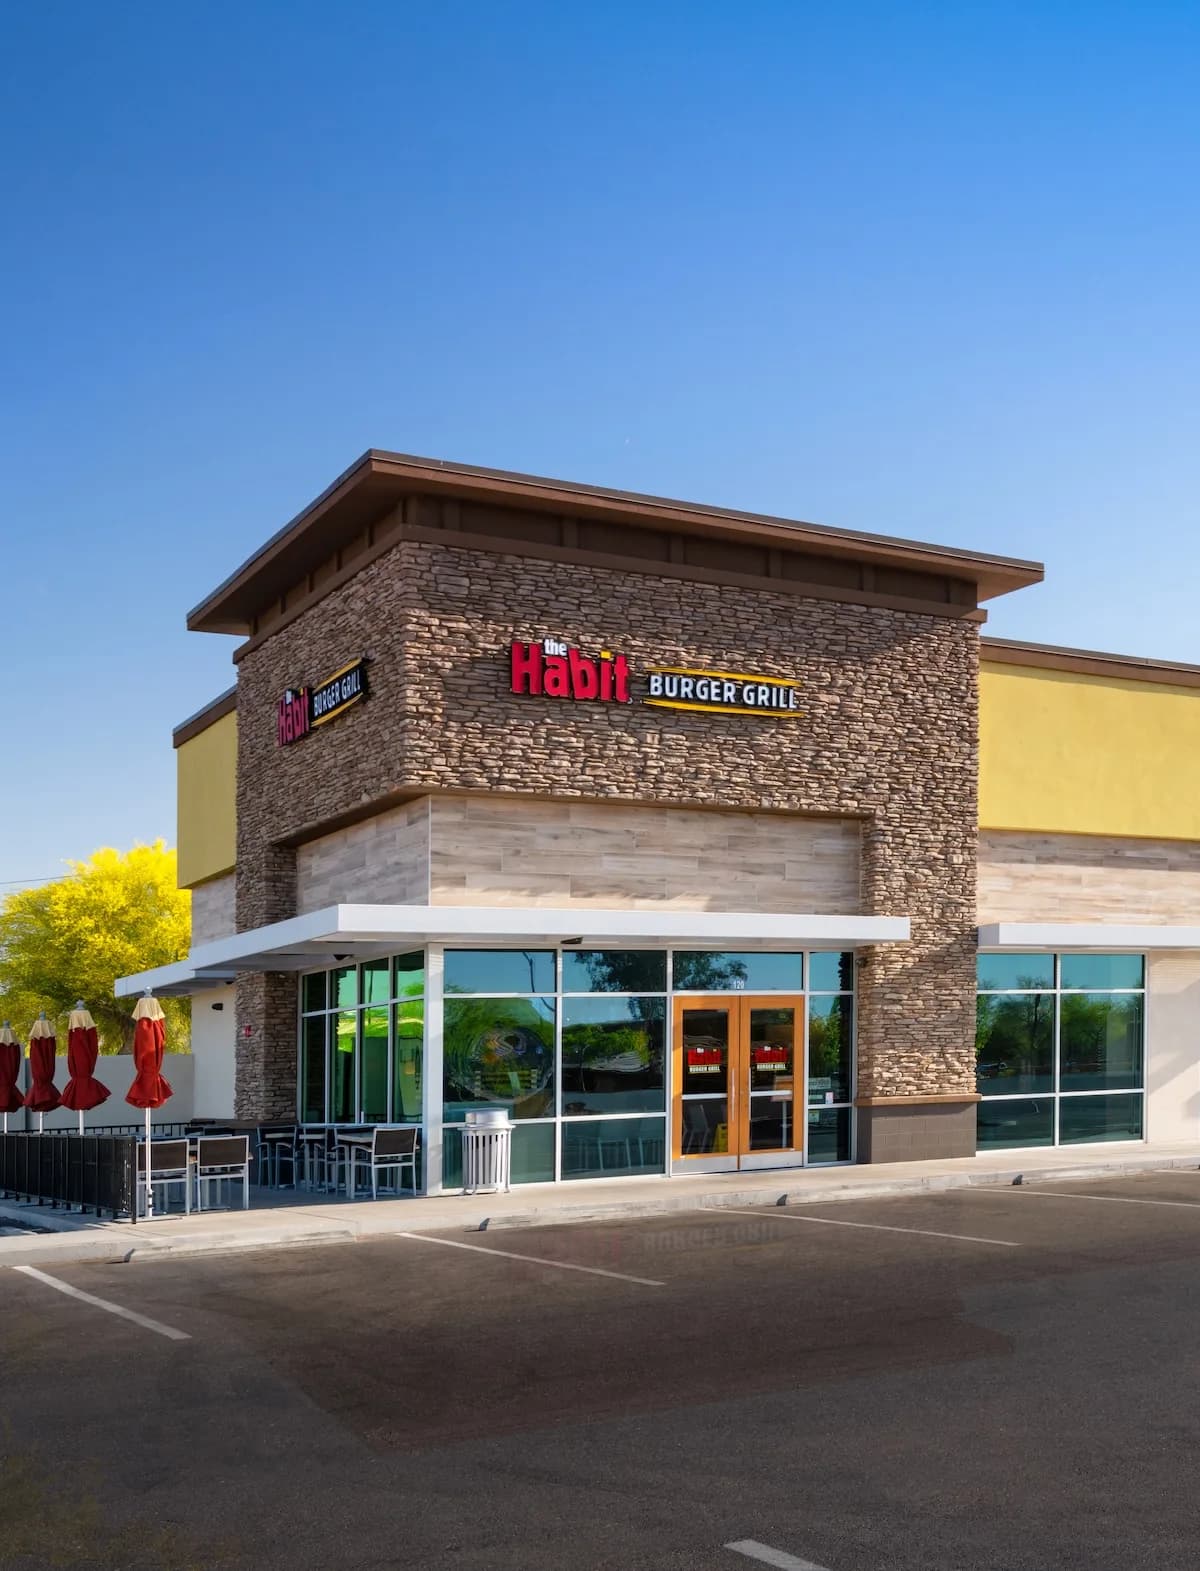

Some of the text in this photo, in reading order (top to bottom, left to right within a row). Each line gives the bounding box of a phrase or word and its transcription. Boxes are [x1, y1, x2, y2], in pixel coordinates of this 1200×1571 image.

[544, 638, 568, 656] the
[511, 641, 629, 703] Habit
[650, 674, 799, 709] BURGER GRILL
[313, 682, 341, 717] BURGER
[341, 669, 361, 700] GRILL
